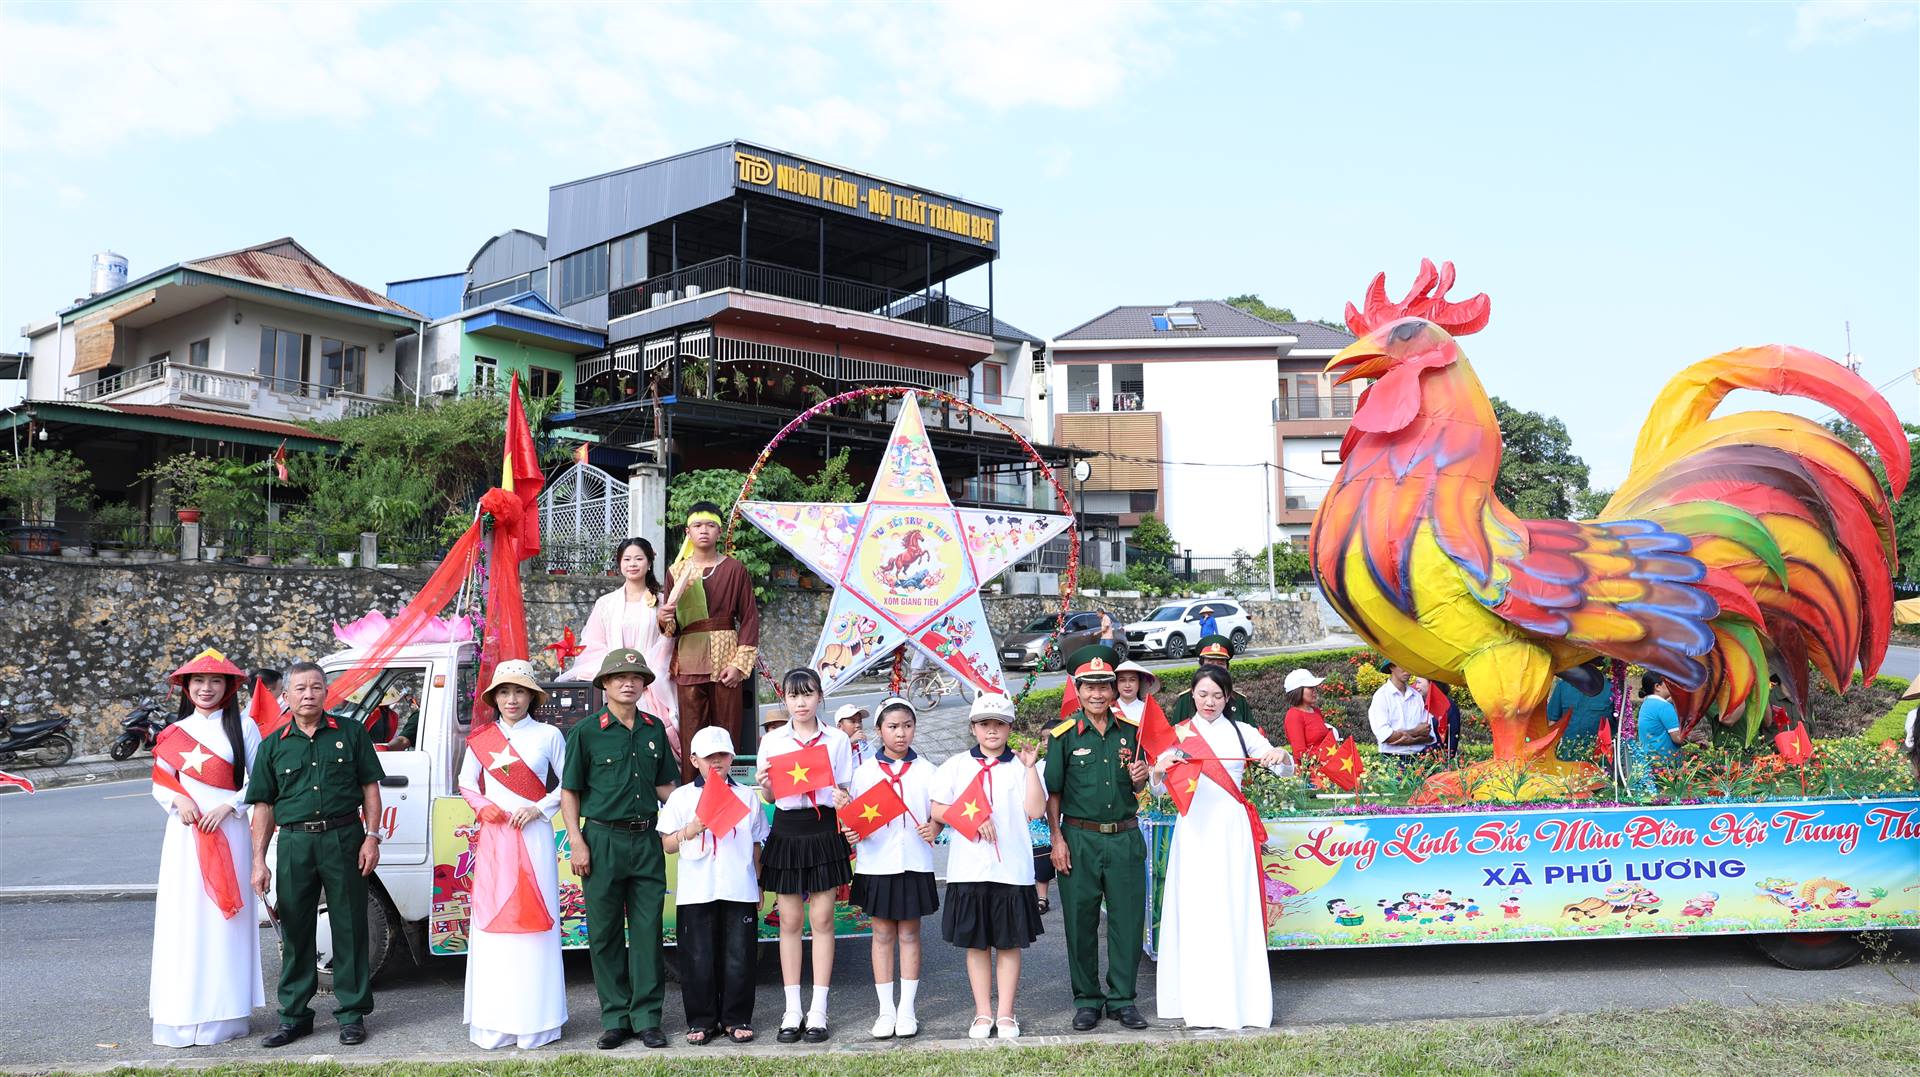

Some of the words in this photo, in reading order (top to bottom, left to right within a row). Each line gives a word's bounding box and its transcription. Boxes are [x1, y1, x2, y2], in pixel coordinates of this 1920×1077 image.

[735, 152, 774, 186] TD
[777, 164, 821, 199] NHÔM
[823, 174, 858, 209] KÍNH
[868, 185, 892, 221] NỘI
[894, 194, 927, 225] THẤT
[971, 215, 995, 245] ĐẠT
[900, 597, 922, 606] GIANG
[1294, 826, 1379, 870] Lung
[1384, 822, 1461, 864] Linh
[1467, 820, 1529, 854] Sắc
[1625, 816, 1696, 848] Đêm
[1703, 813, 1768, 848] Hội
[1772, 810, 1860, 854] Trung
[1482, 863, 1532, 886] XÃ
[1545, 859, 1612, 884] PHÚ
[1626, 858, 1746, 881] LƯƠNG
